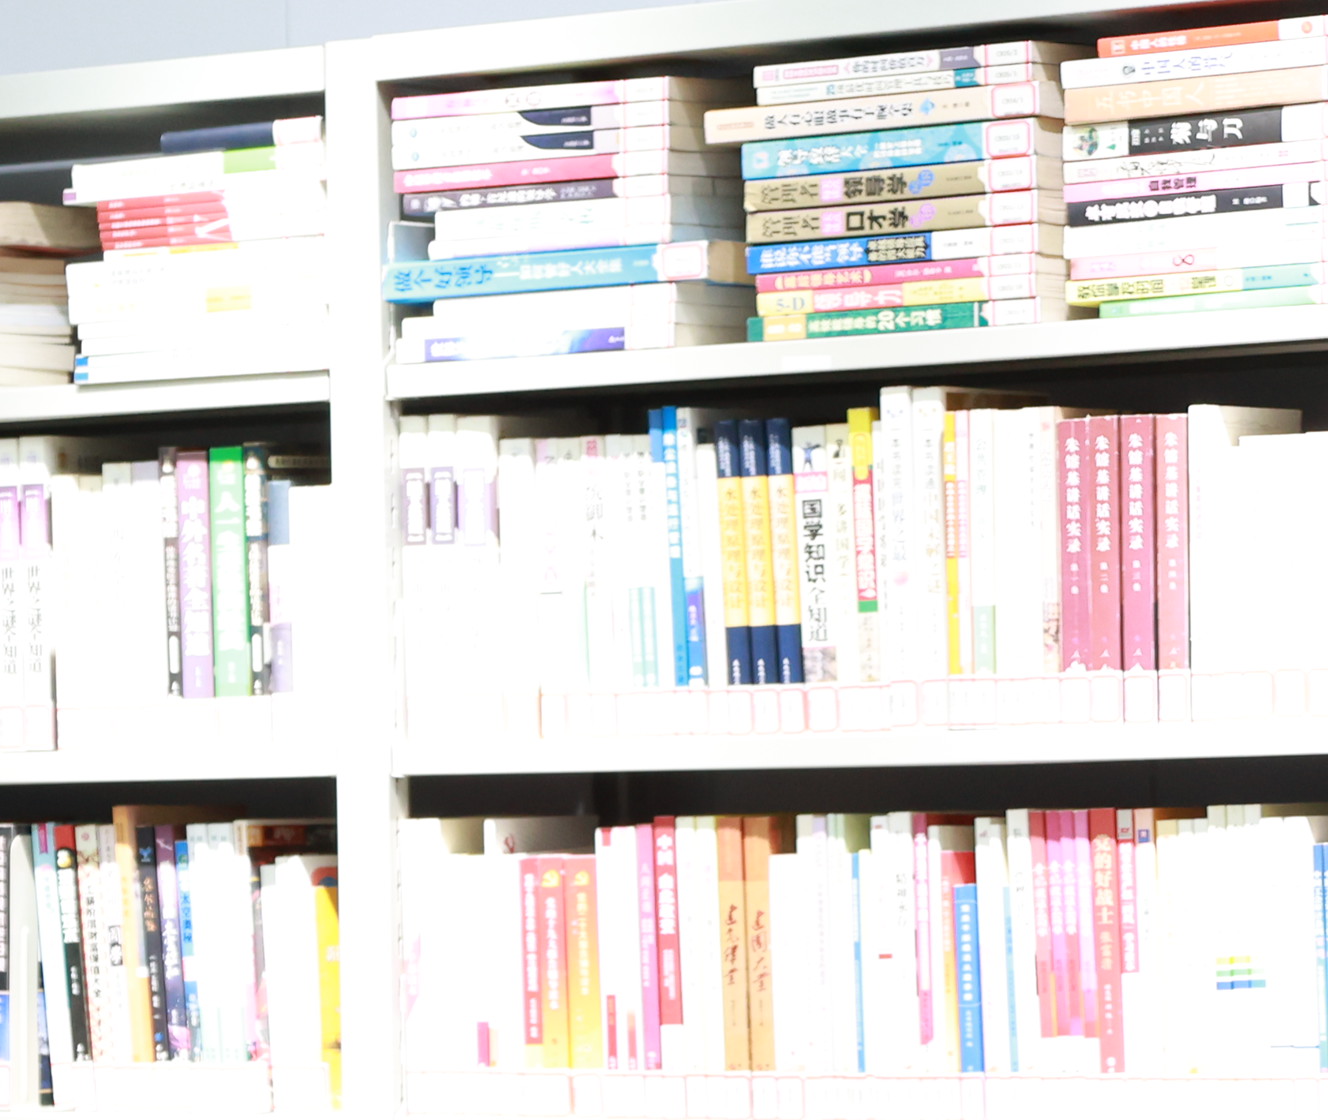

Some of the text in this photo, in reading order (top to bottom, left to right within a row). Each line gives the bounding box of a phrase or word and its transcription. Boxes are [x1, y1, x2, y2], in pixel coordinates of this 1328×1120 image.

[1171, 117, 1243, 143] 菊与刀
[845, 205, 909, 231] 口才学
